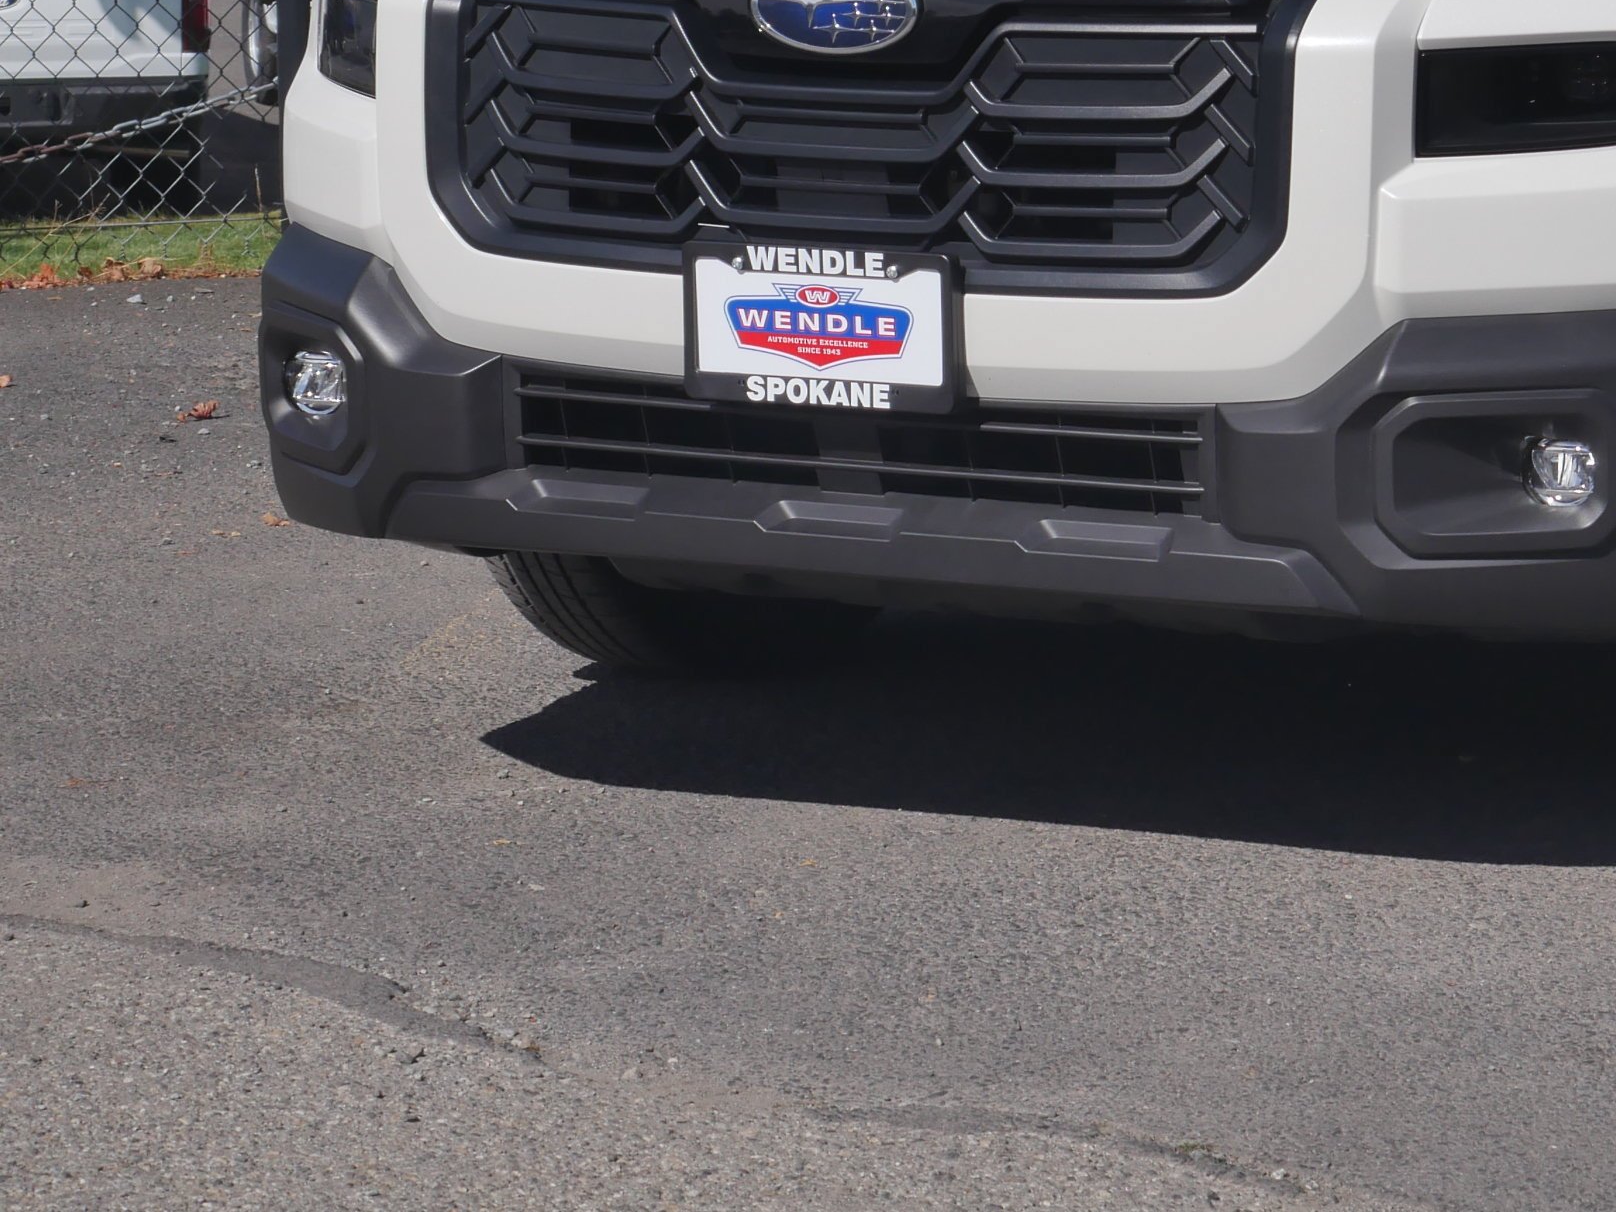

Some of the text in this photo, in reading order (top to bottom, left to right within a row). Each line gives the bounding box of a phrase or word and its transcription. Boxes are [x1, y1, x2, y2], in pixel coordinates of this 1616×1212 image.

[746, 245, 886, 277] WENDLE
[738, 308, 896, 336] WENDLE
[767, 335, 869, 349] AUTOMOTIVE EXCELLENCE
[797, 346, 841, 356] SINCE 1943
[746, 375, 892, 409] SPOKANE
